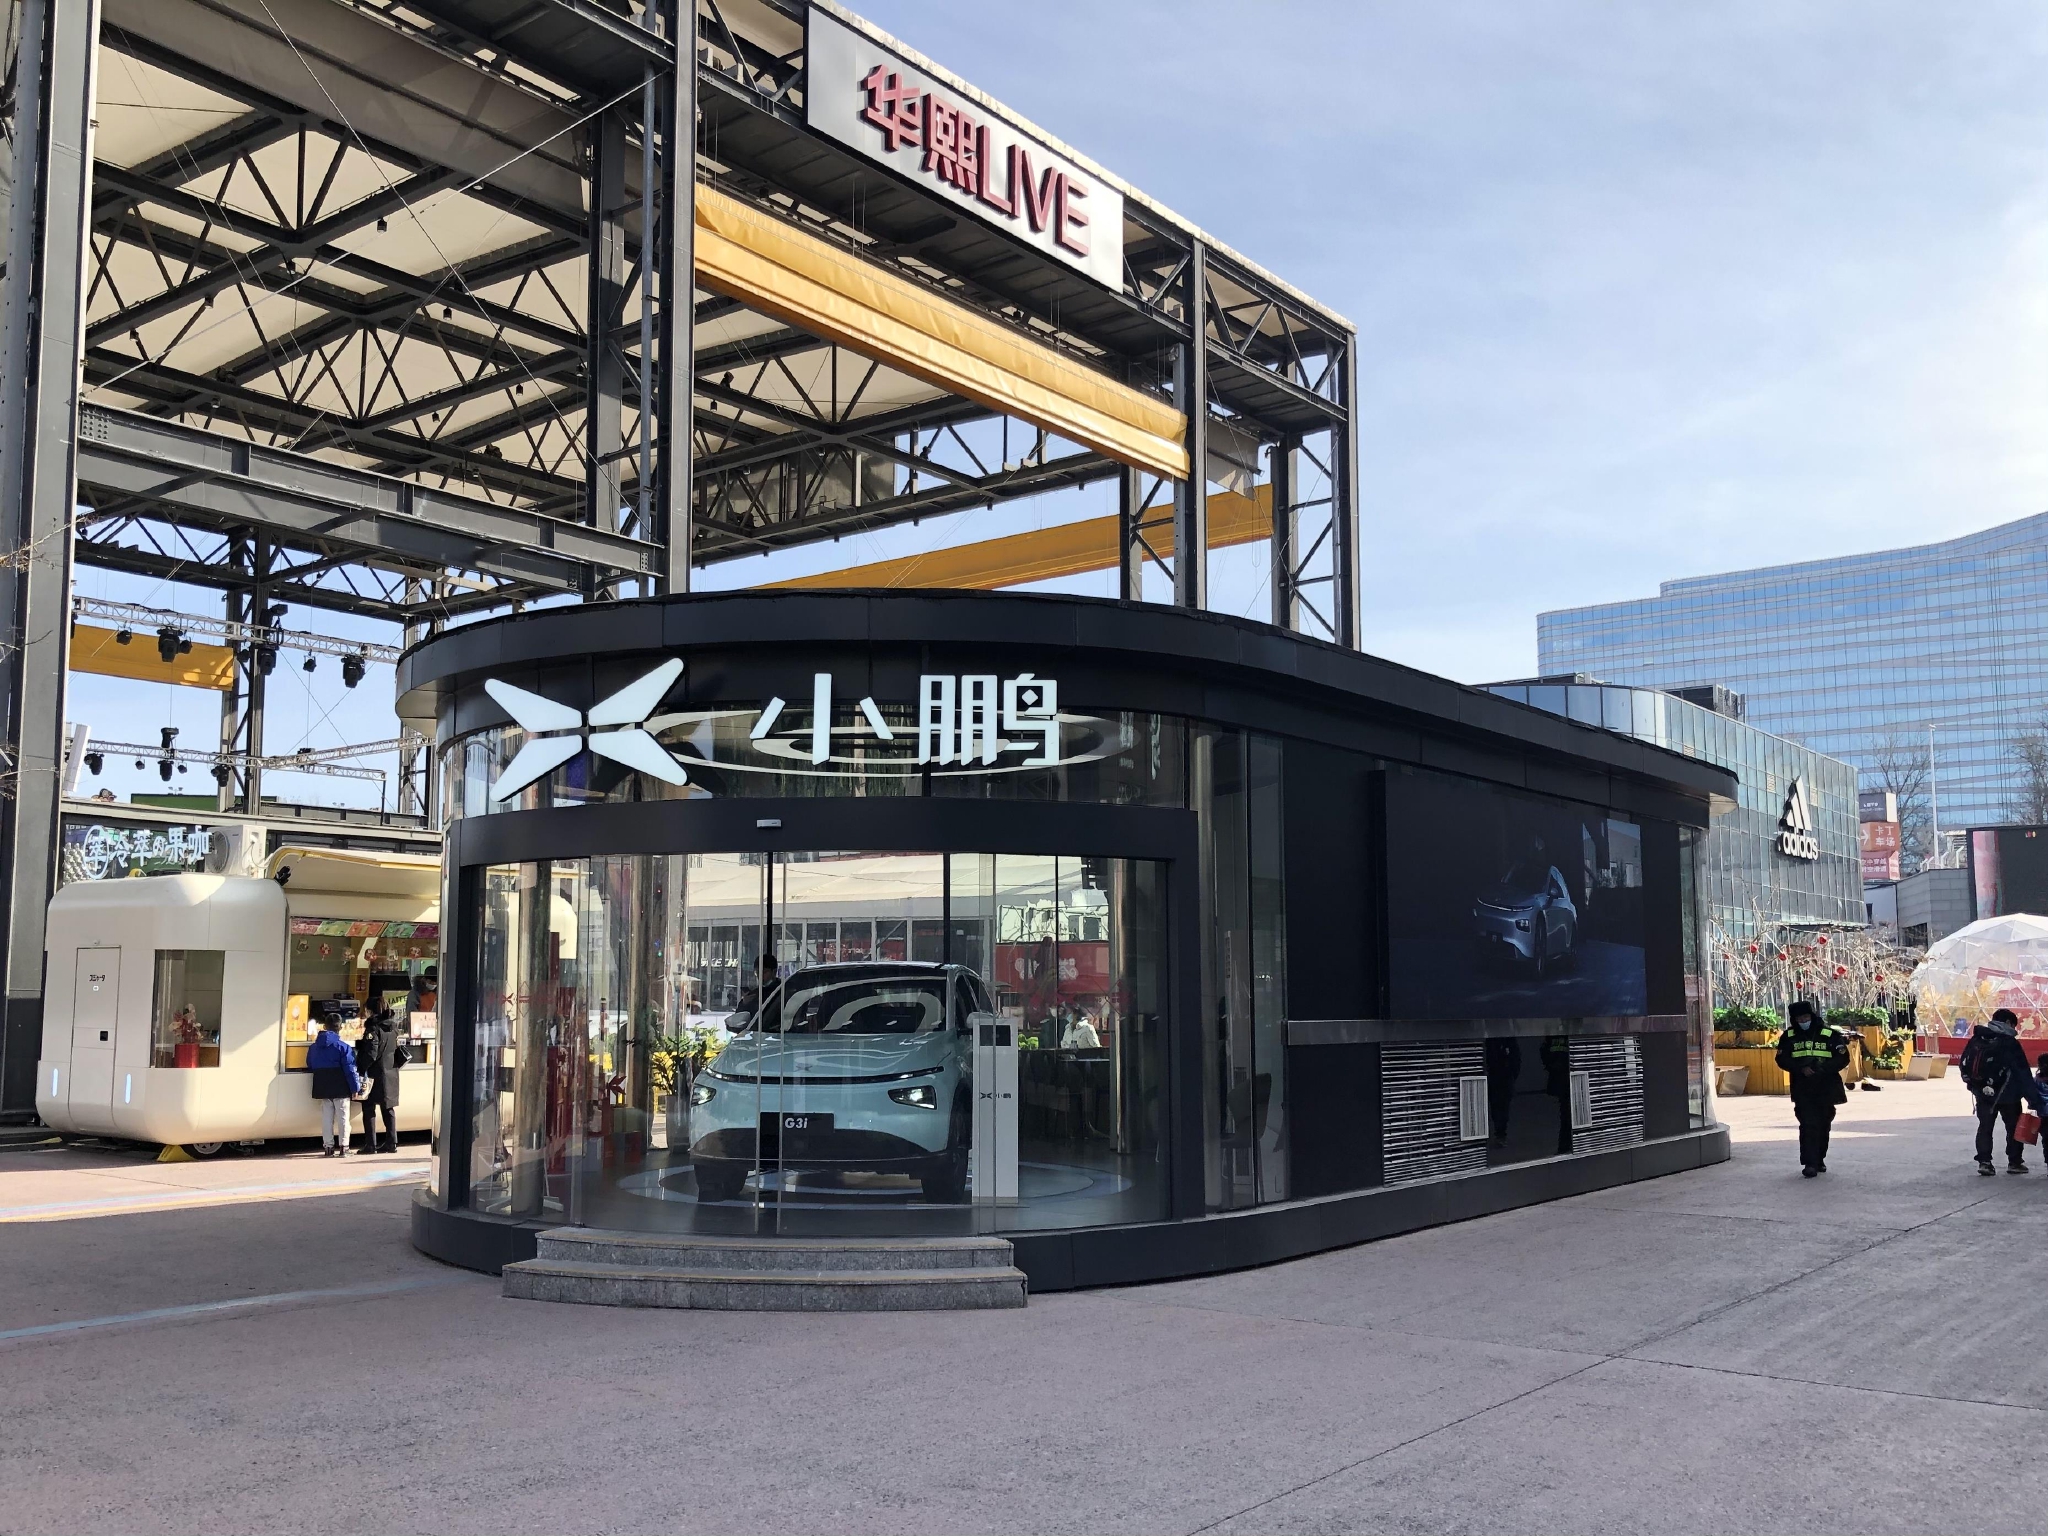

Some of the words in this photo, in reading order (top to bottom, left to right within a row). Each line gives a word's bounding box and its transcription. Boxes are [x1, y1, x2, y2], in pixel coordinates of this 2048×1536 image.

[862, 64, 1089, 257] 华熙LIVE
[749, 672, 1060, 767] 小鹏
[1782, 827, 1819, 860] adidas
[784, 1117, 809, 1129] G3i
